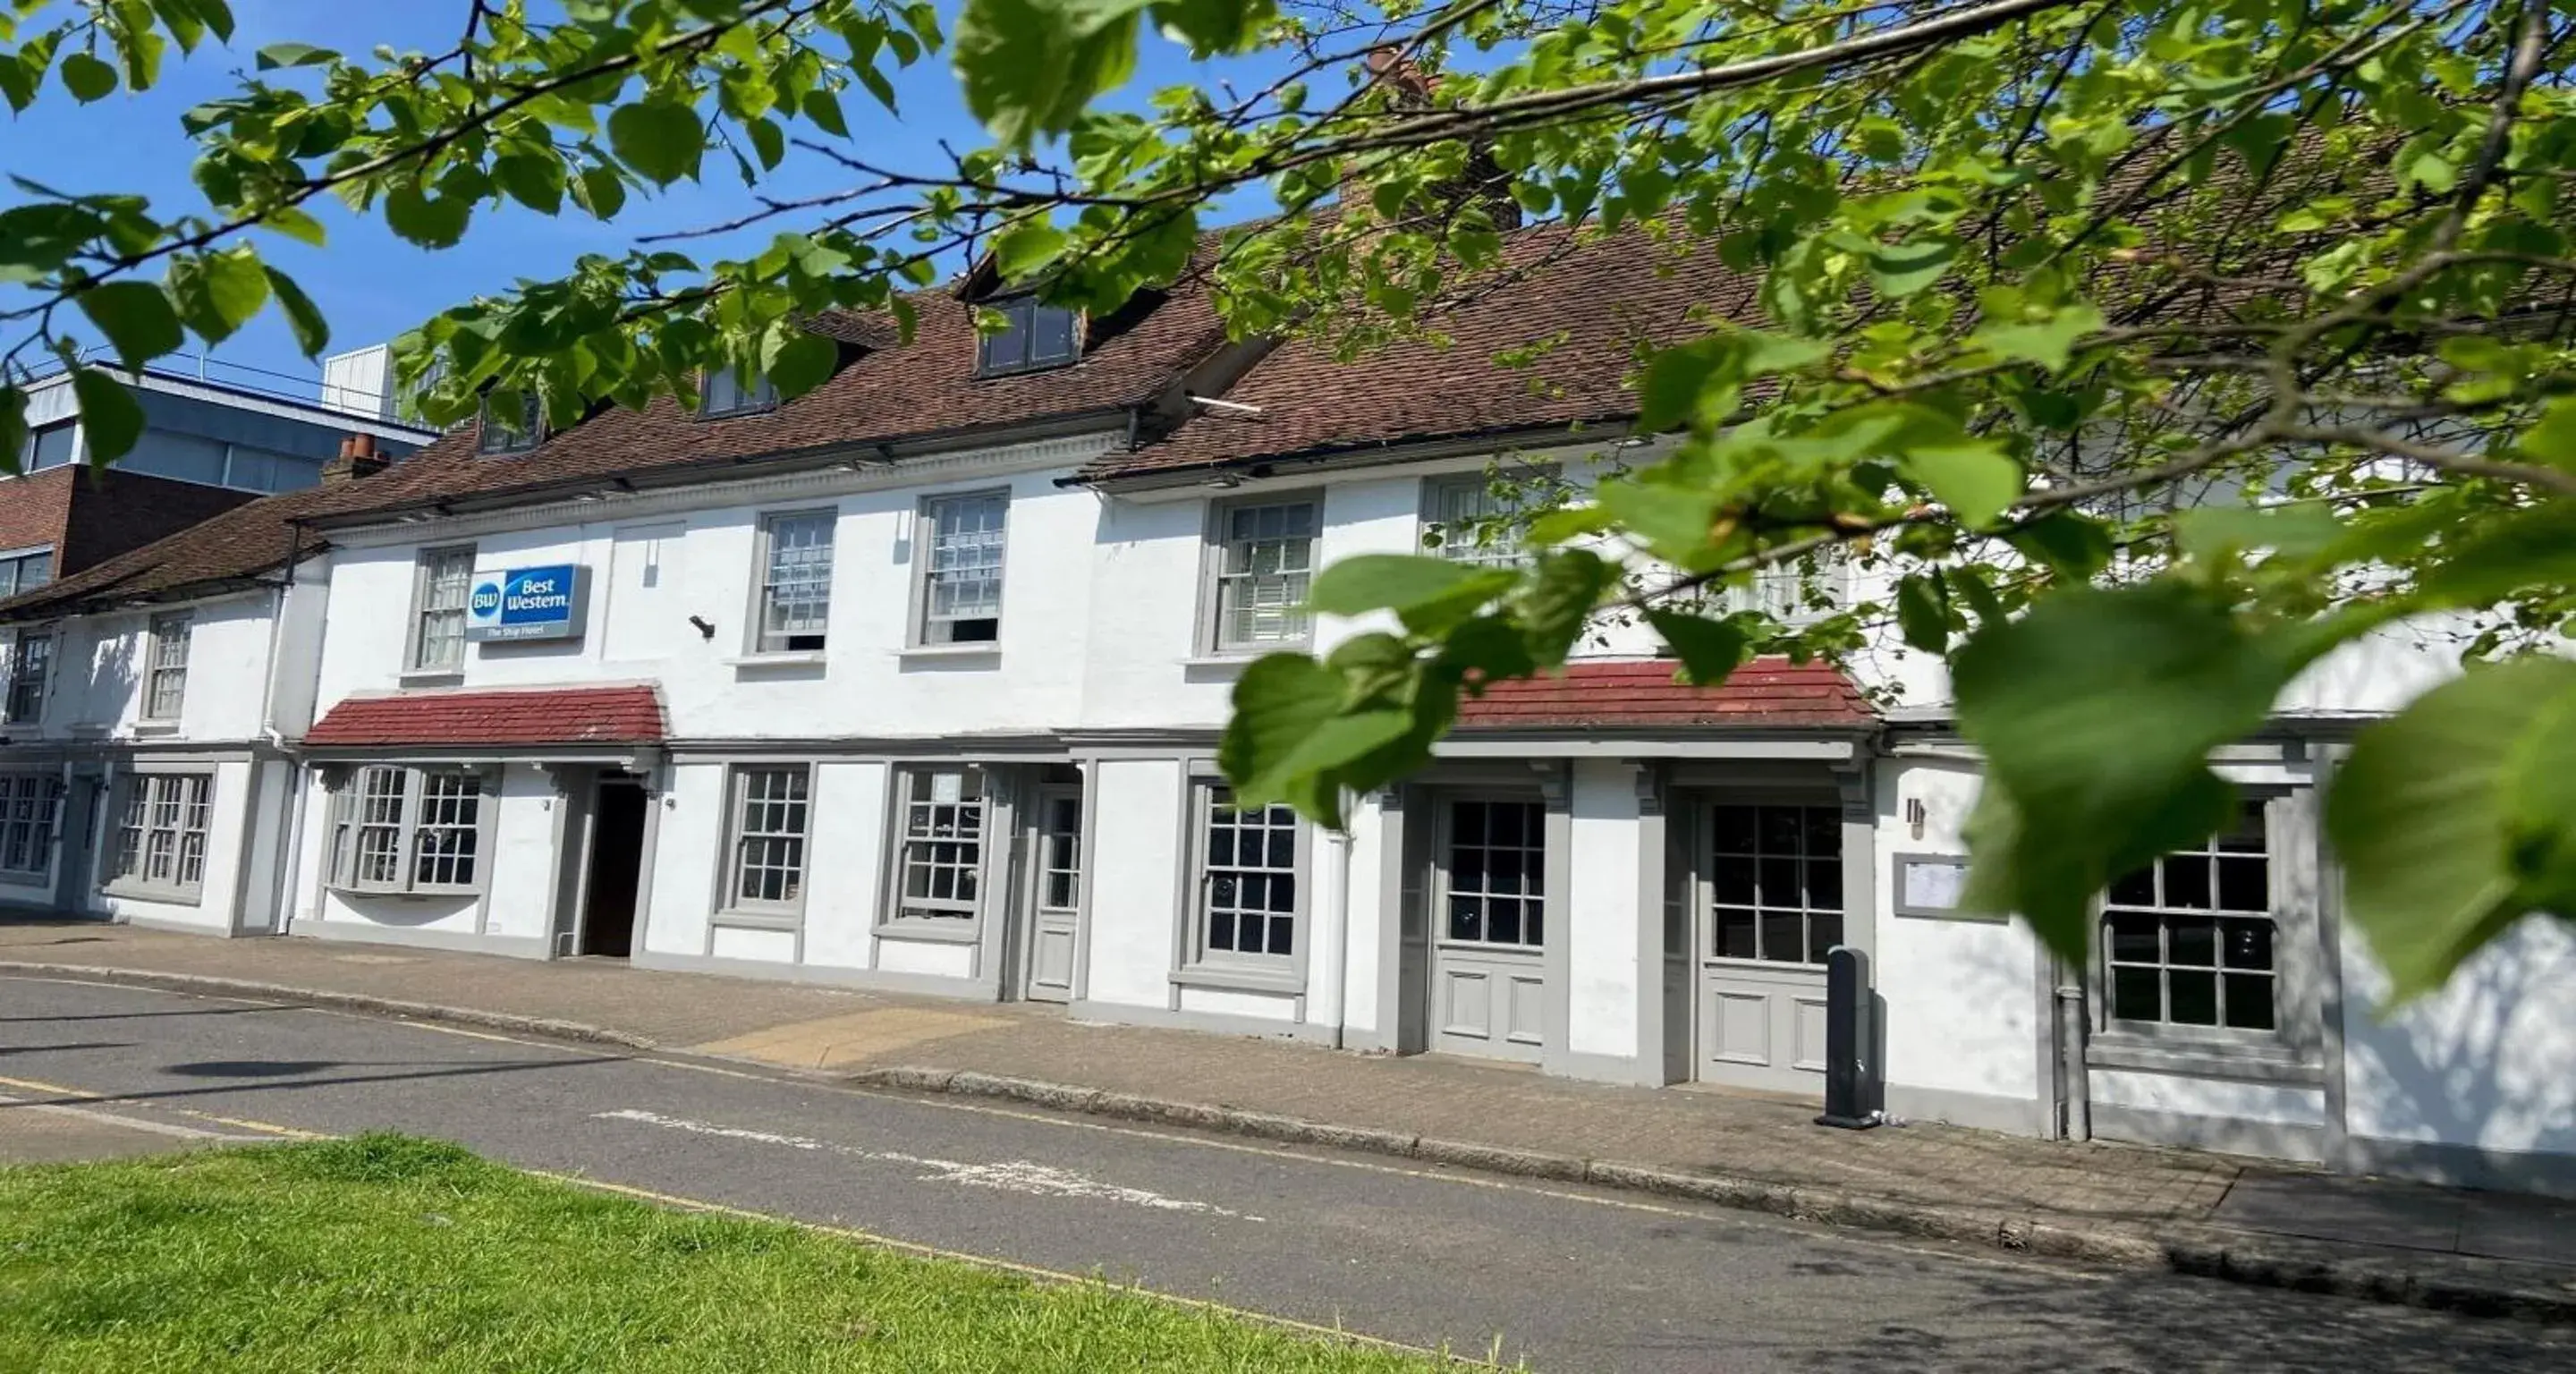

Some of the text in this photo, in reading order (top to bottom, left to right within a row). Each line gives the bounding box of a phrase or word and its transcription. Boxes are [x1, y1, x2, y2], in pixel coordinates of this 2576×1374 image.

[522, 579, 555, 594] Best
[474, 593, 496, 608] BW
[487, 628, 501, 637] The
